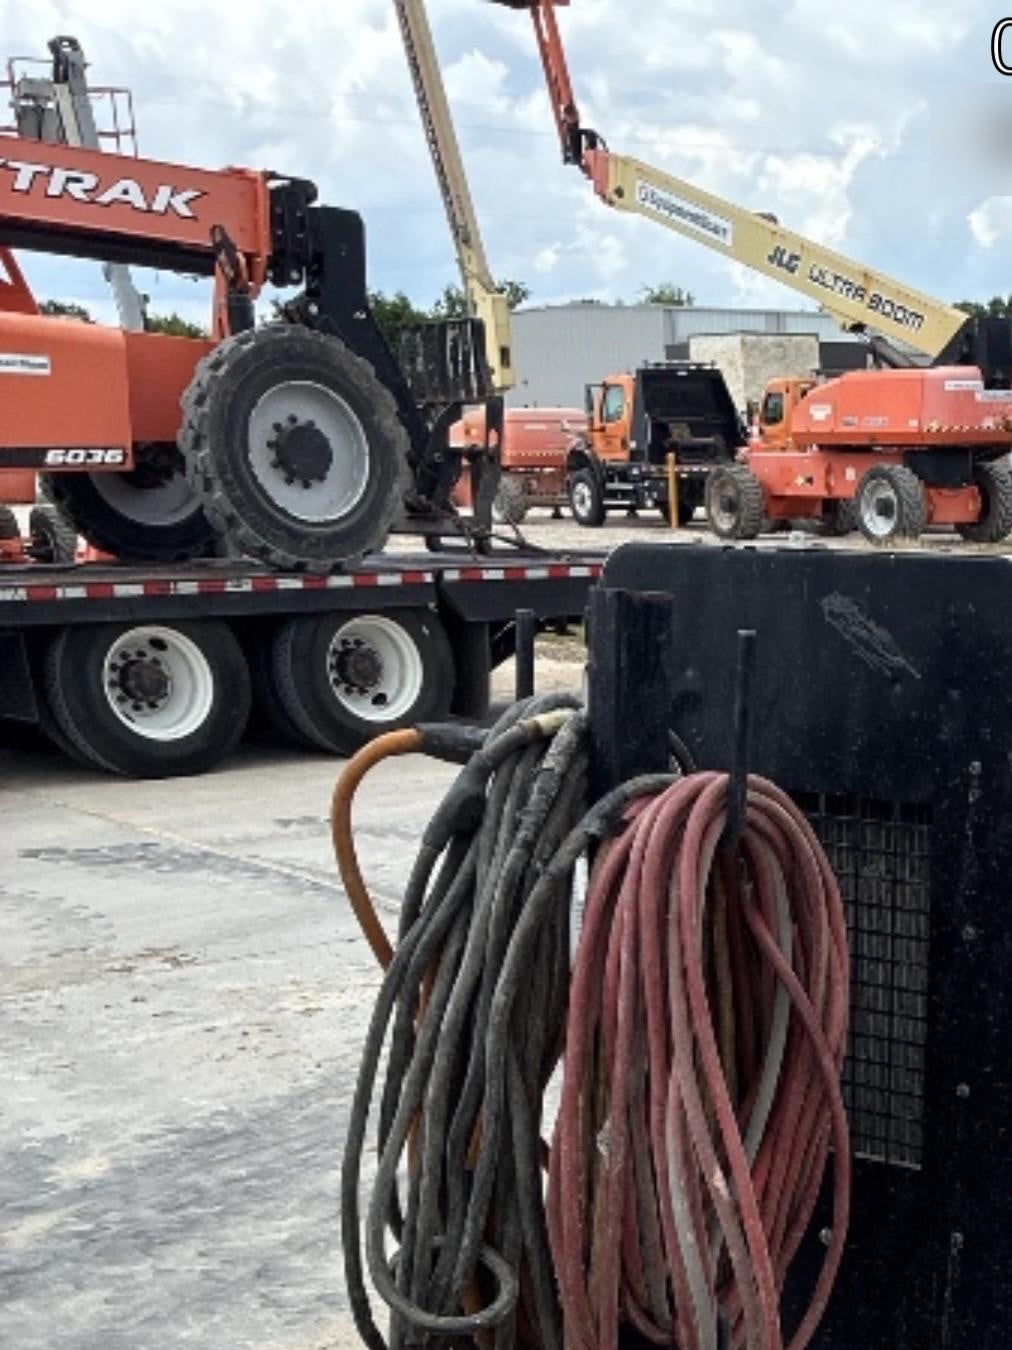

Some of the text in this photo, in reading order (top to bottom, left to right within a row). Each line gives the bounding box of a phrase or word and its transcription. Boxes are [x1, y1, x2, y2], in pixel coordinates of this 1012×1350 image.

[0, 158, 208, 220] TRAK
[768, 246, 925, 333] JLG ULTRA BOOM
